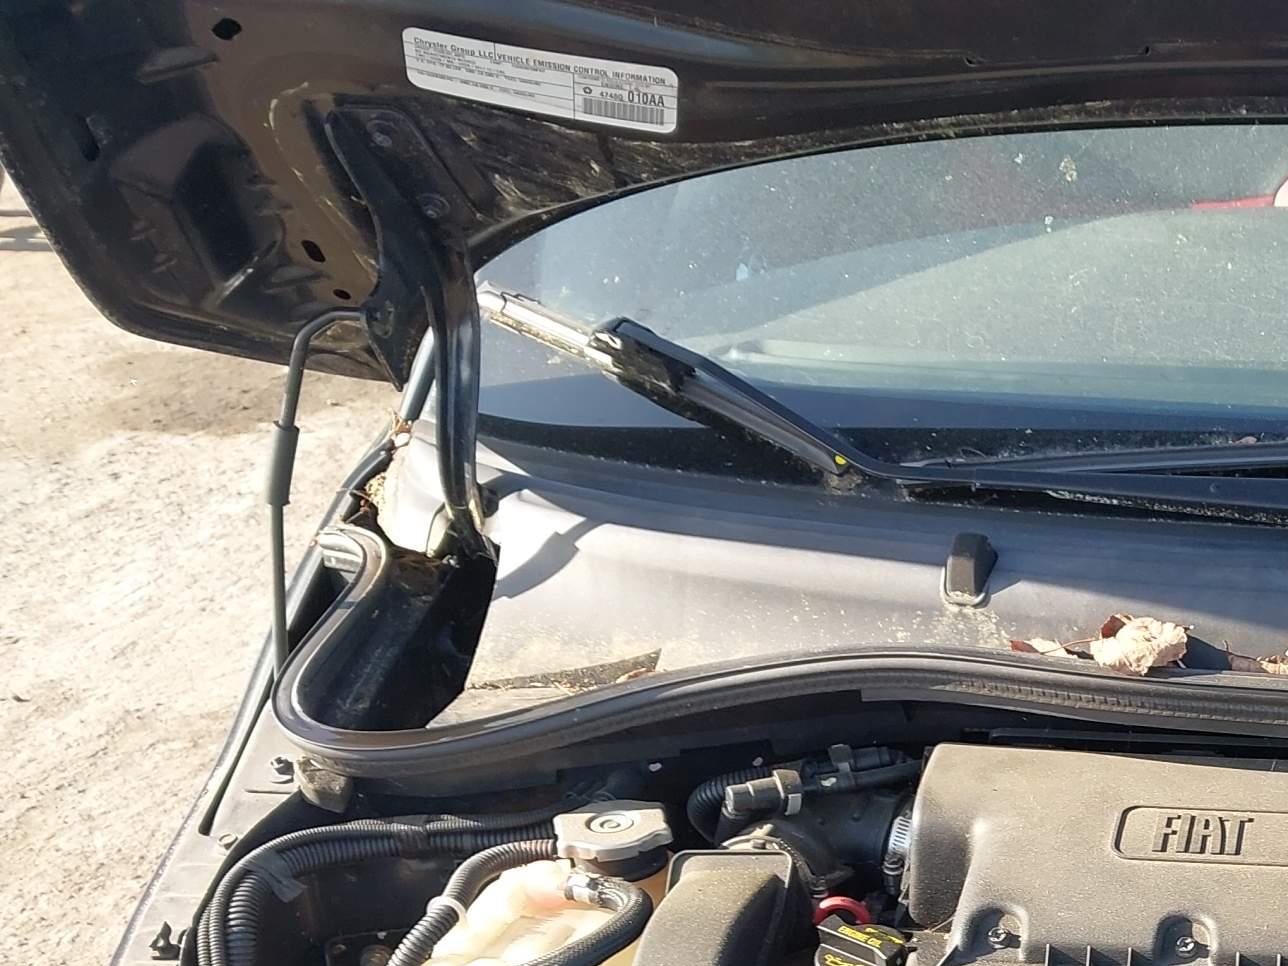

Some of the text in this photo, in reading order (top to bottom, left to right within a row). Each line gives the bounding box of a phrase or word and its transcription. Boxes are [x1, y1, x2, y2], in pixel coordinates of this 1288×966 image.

[414, 37, 448, 50] Chrysler
[450, 44, 476, 57] Group
[478, 49, 494, 58] LLC
[497, 53, 531, 64] VEHICLE
[533, 58, 571, 71] EMISSION
[573, 65, 608, 78] CONTROL
[611, 71, 666, 84] INFORMATION
[627, 90, 665, 106] 010AA
[1151, 813, 1254, 856] FIAT
